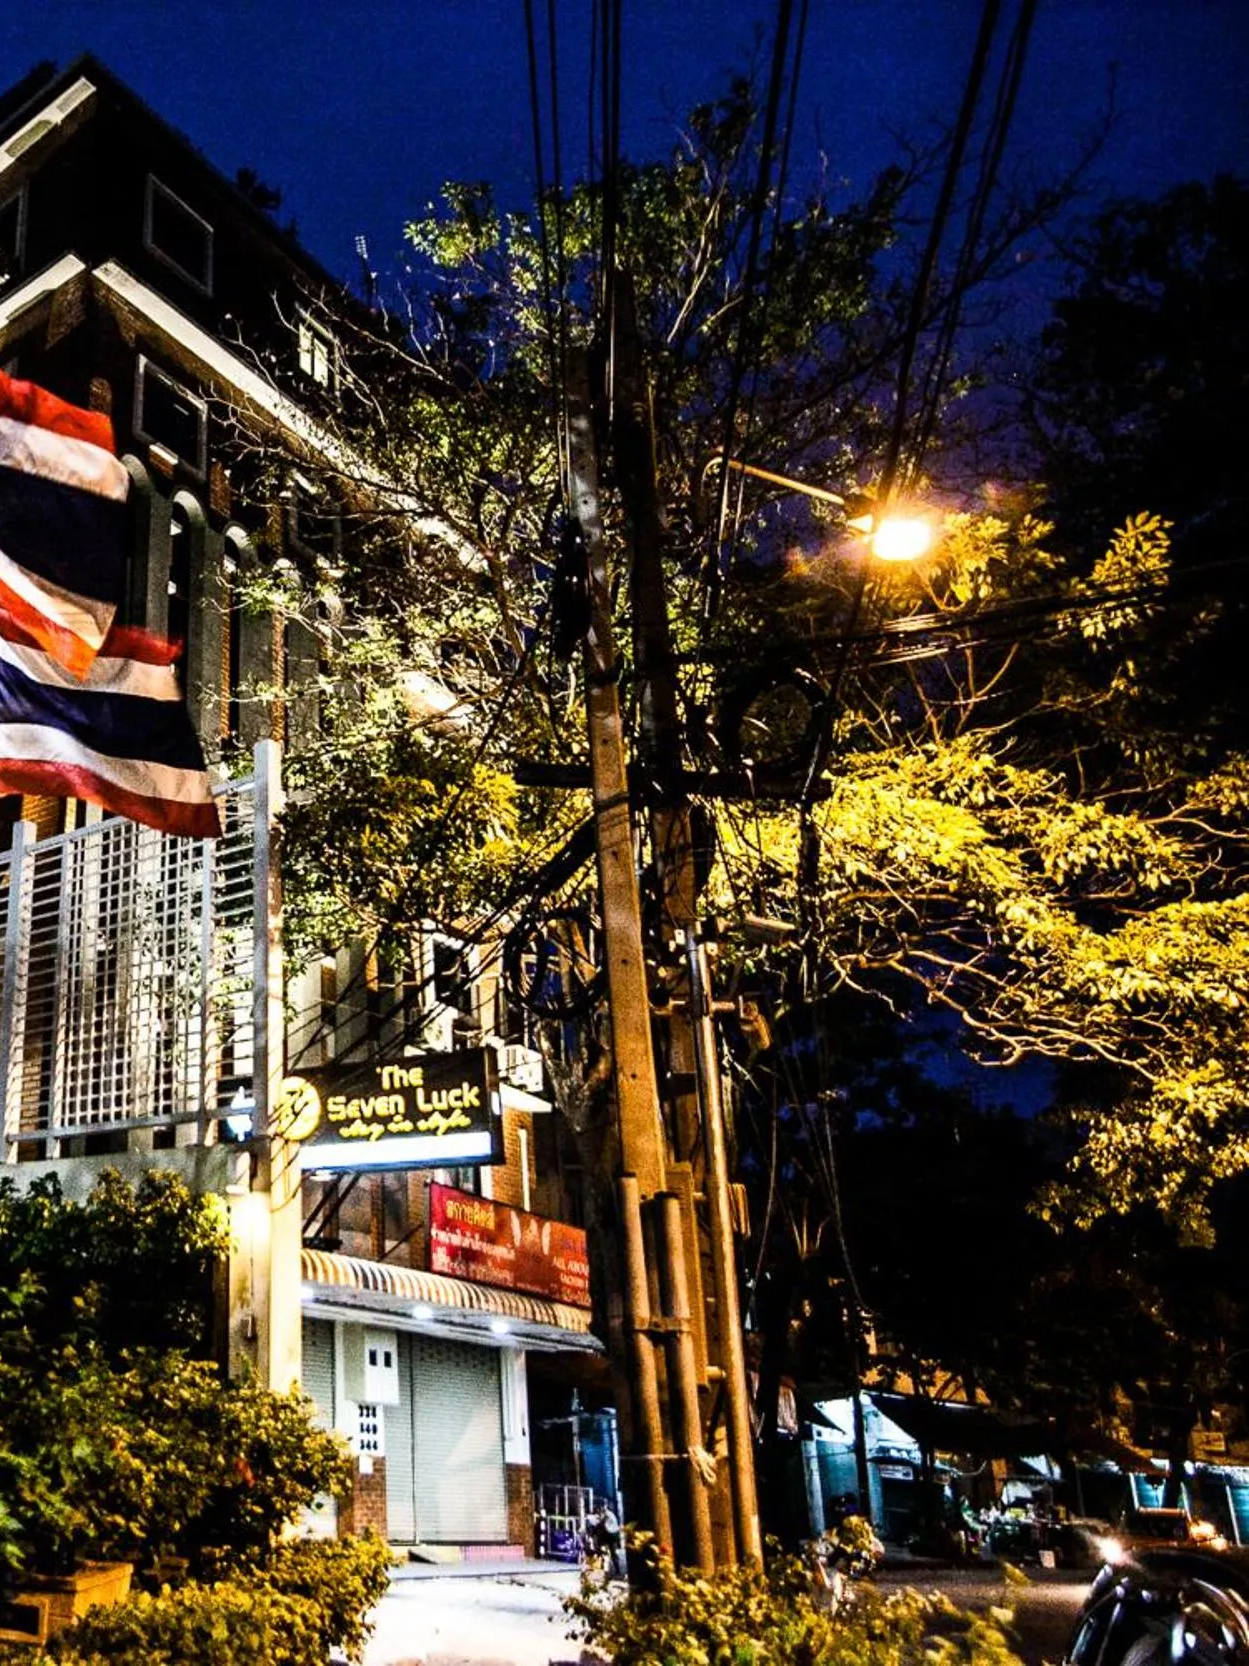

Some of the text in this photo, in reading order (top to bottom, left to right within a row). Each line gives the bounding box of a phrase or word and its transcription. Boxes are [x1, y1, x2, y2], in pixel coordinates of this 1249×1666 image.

[377, 1064, 424, 1090] The
[326, 1080, 481, 1122] Seven Luck
[387, 1114, 415, 1134] in
